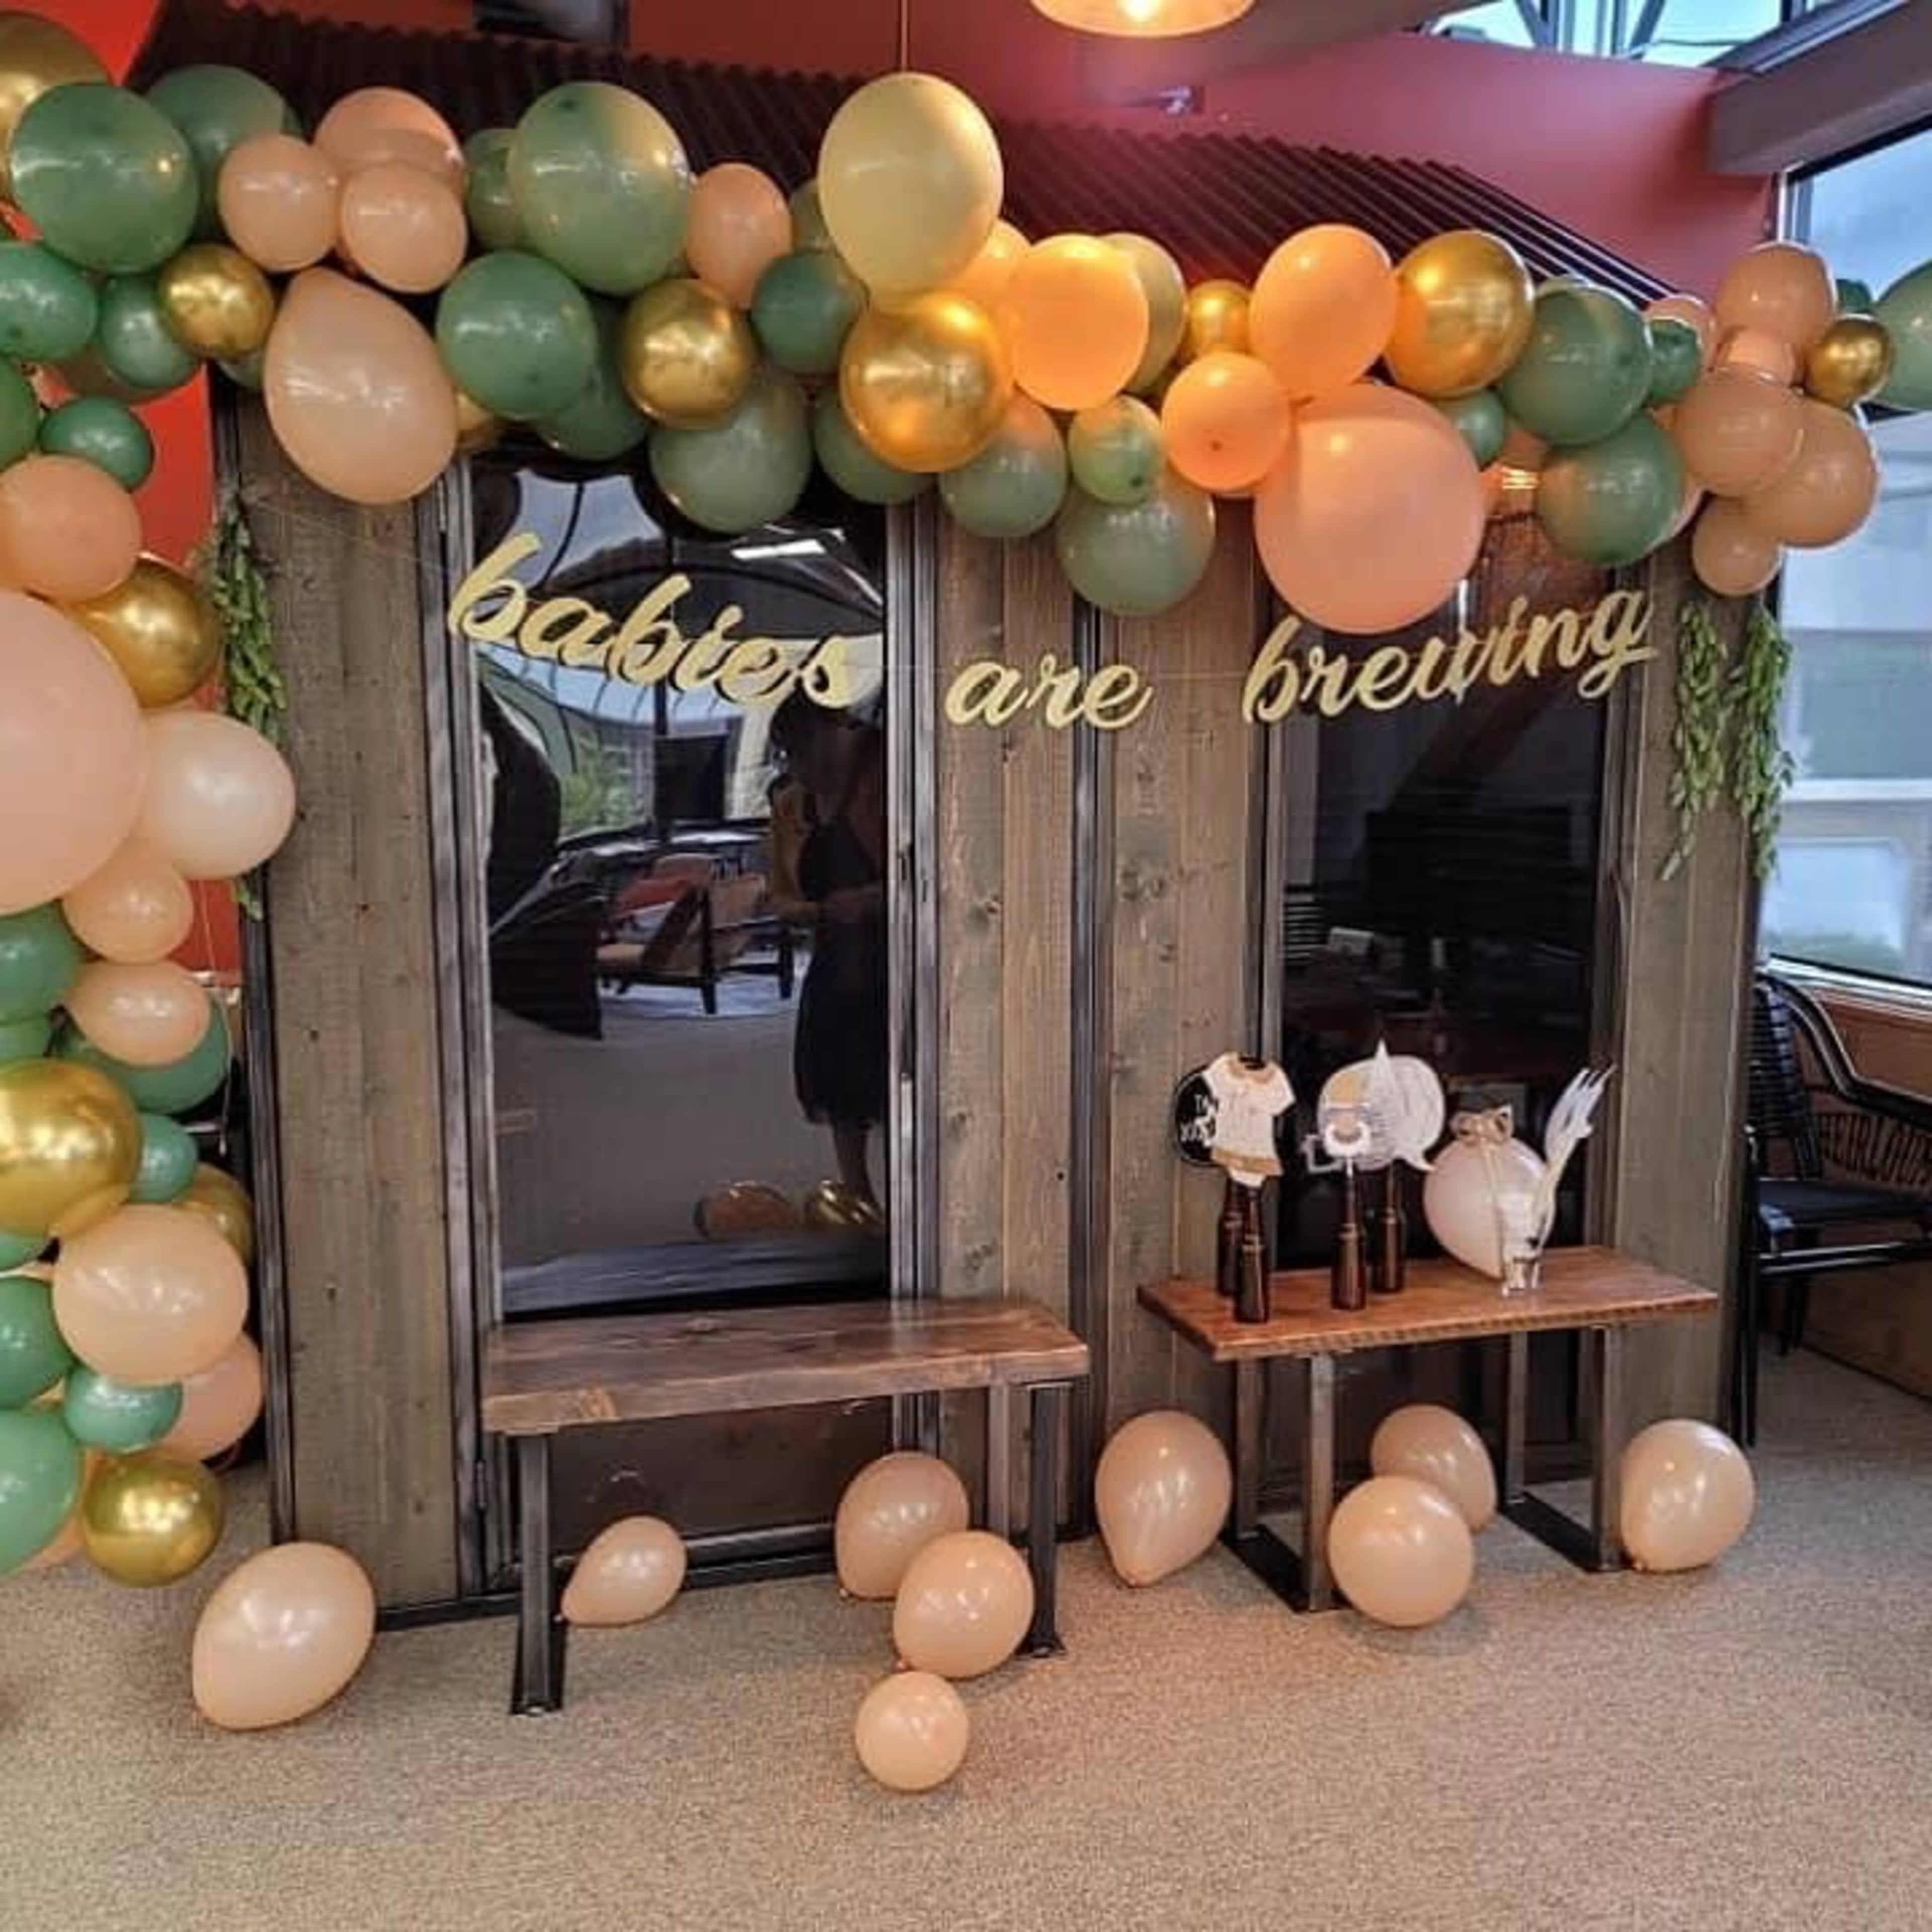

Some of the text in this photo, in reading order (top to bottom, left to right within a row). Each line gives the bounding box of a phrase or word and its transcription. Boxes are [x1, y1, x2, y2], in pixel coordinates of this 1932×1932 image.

[447, 531, 1659, 730] babies are brewing
